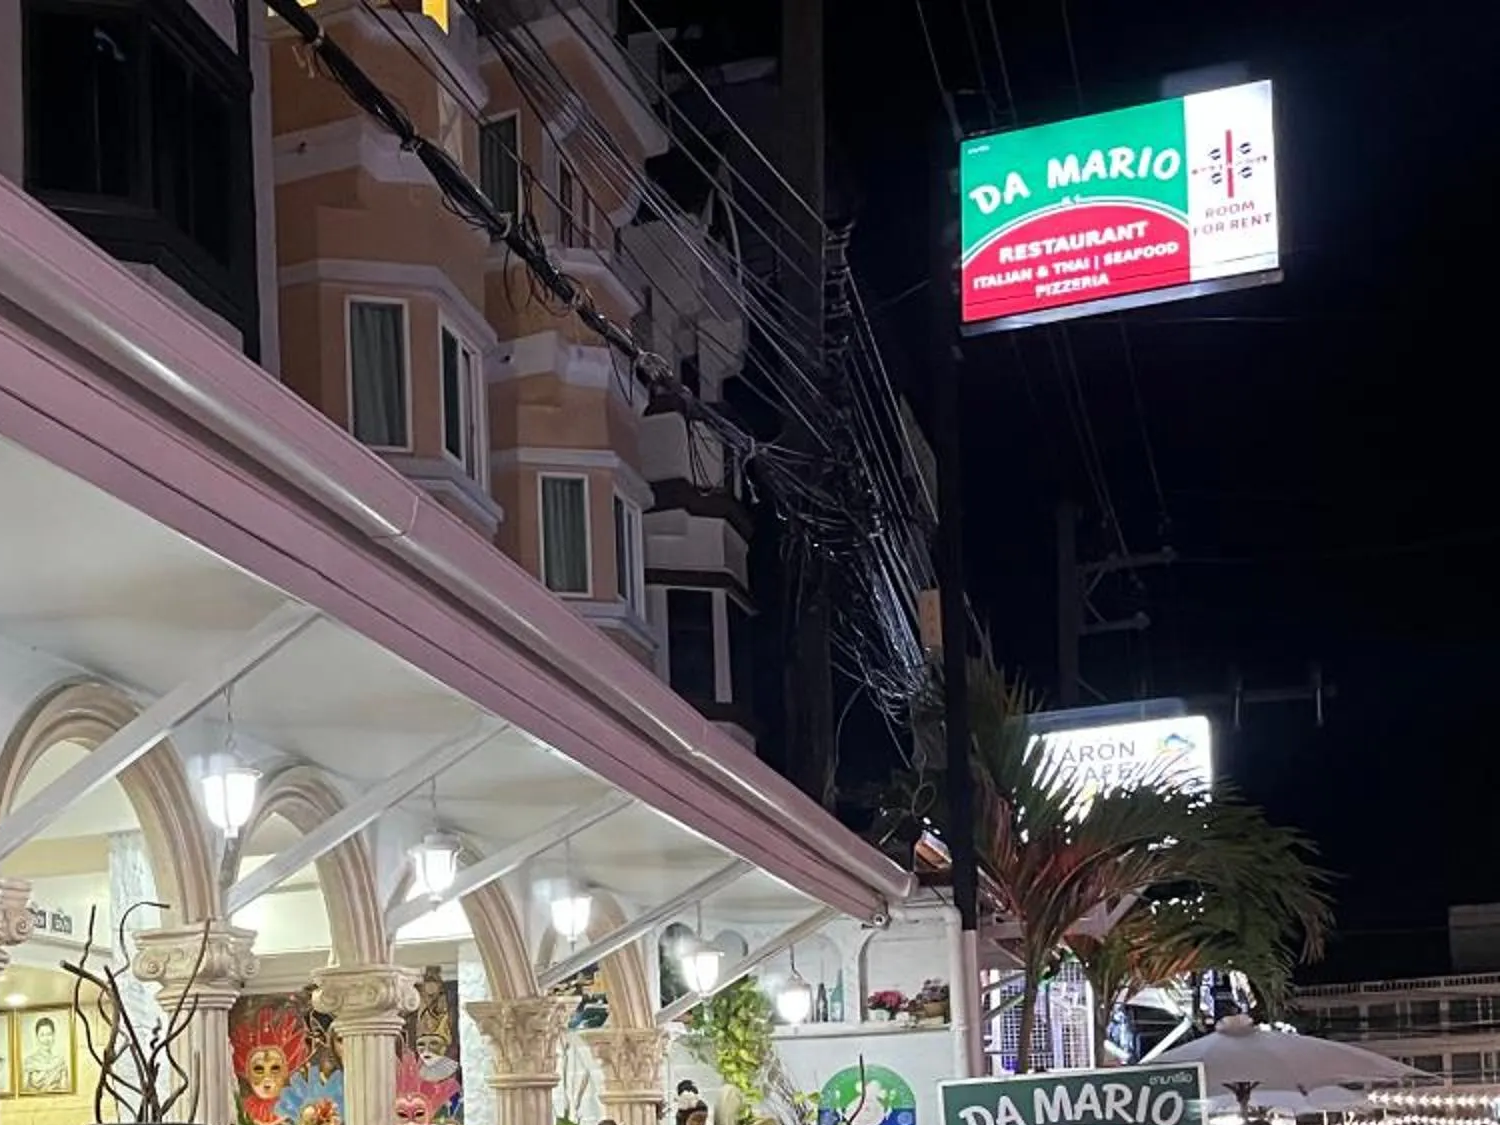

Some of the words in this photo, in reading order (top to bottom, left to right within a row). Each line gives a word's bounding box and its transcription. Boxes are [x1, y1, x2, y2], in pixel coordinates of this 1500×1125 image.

[969, 171, 1031, 215] DA
[1047, 146, 1181, 189] MARIO
[1193, 221, 1224, 237] FOR
[1230, 212, 1271, 229] RENT
[1205, 200, 1255, 218] ROOM
[999, 221, 1149, 264] RESTAURANT
[973, 267, 1033, 290] ITALIAN
[1036, 265, 1049, 279] &
[1052, 257, 1090, 275] THAI
[1103, 242, 1180, 266] SEAFOOD
[1035, 273, 1110, 298] PIZZERIA
